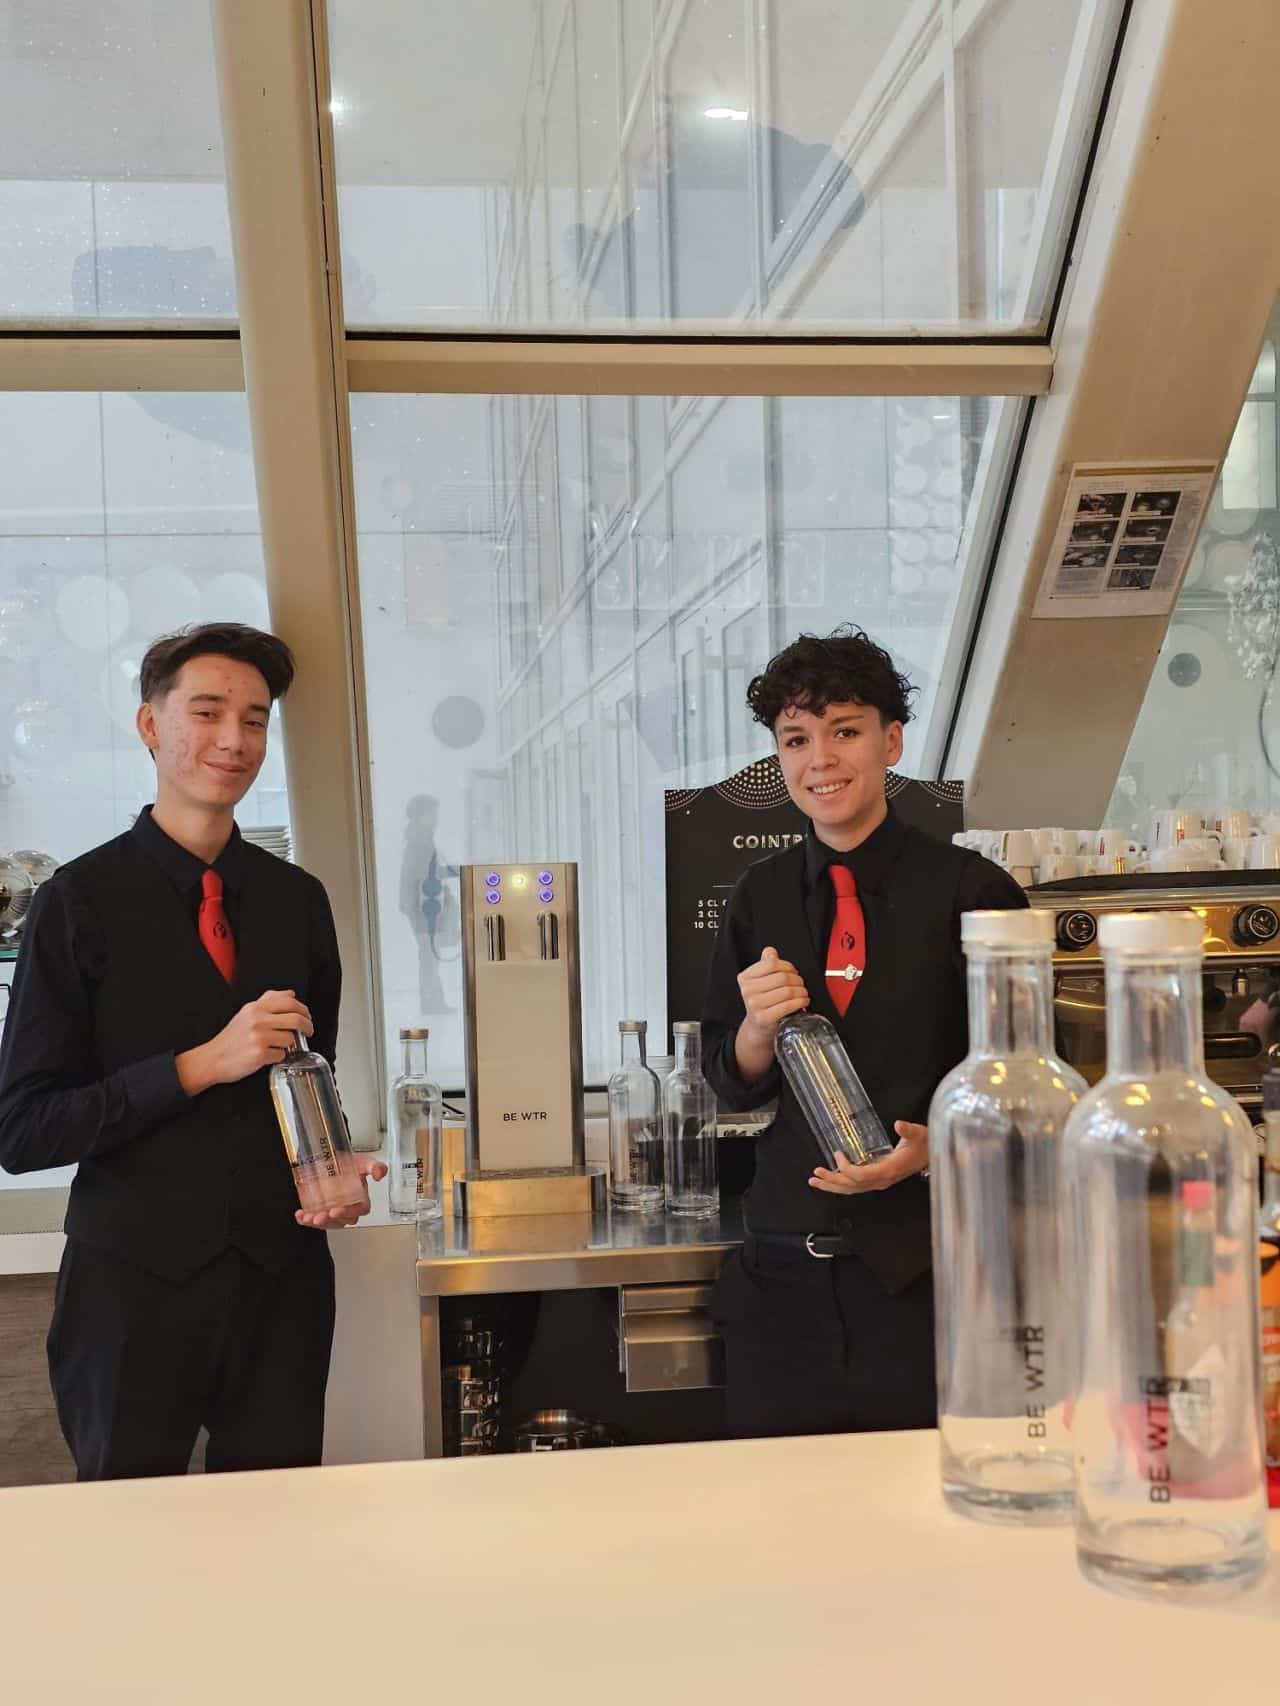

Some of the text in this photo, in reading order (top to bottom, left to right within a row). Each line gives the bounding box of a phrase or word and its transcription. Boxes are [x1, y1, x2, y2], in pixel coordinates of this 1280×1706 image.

[732, 834, 808, 849] COINTR
[707, 899, 719, 907] CL
[697, 910, 719, 918] 2 CL
[694, 920, 719, 929] 10 CL
[503, 1111, 547, 1121] BE WTR
[1024, 1325, 1046, 1438] BE WTR
[1147, 1378, 1170, 1502] BE WTR
